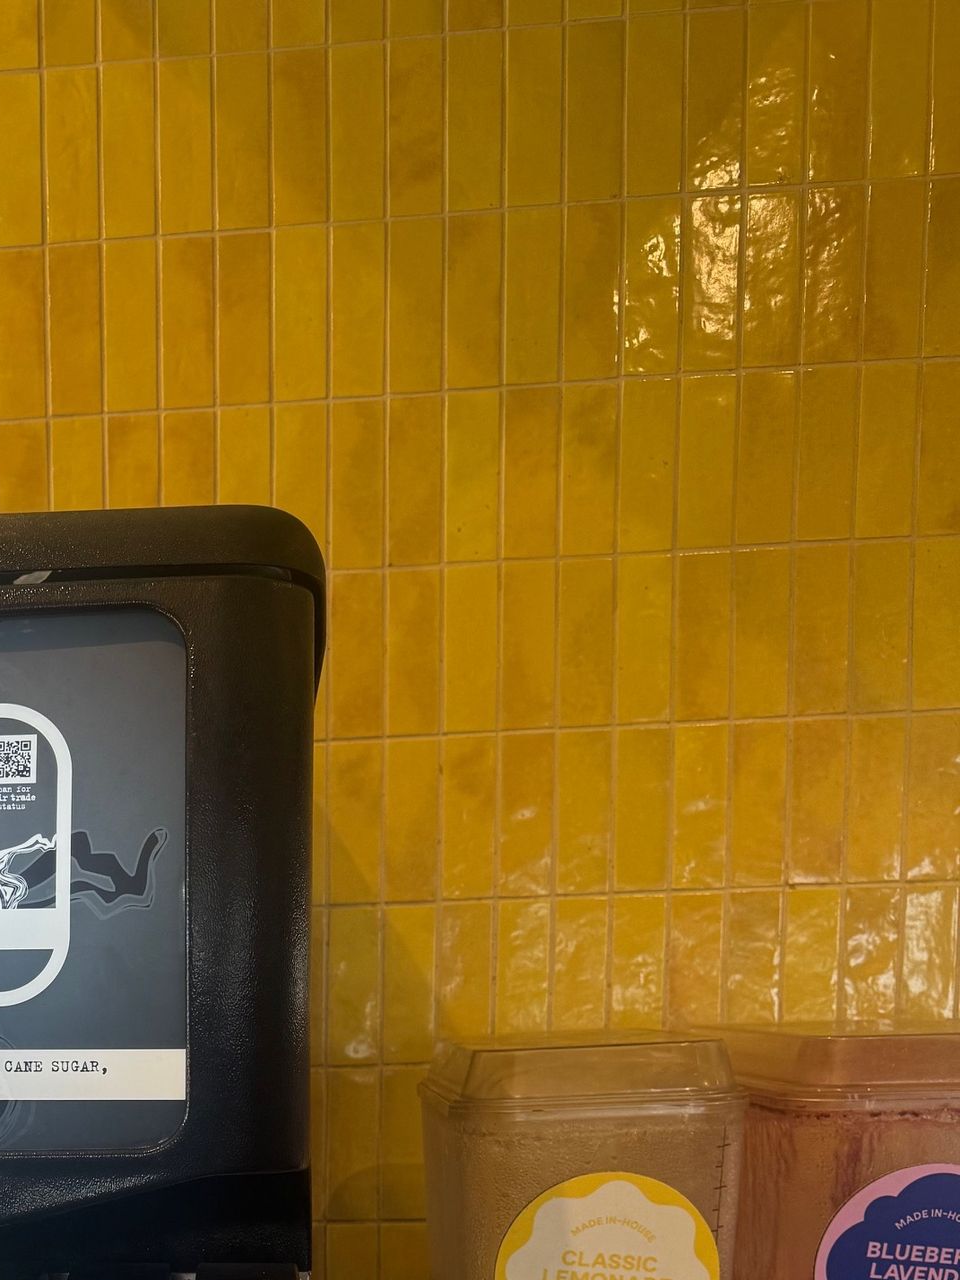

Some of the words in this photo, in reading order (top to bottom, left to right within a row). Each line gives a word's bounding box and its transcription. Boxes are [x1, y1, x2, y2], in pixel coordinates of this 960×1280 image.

[11, 793, 36, 802] trade
[4, 1060, 43, 1073] CANE
[51, 1060, 108, 1075] SUGAR,
[571, 1217, 605, 1237] MADE
[605, 1216, 657, 1243] IN-HOUSE
[895, 1209, 929, 1230] MADE
[561, 1250, 658, 1273] CLASSIC
